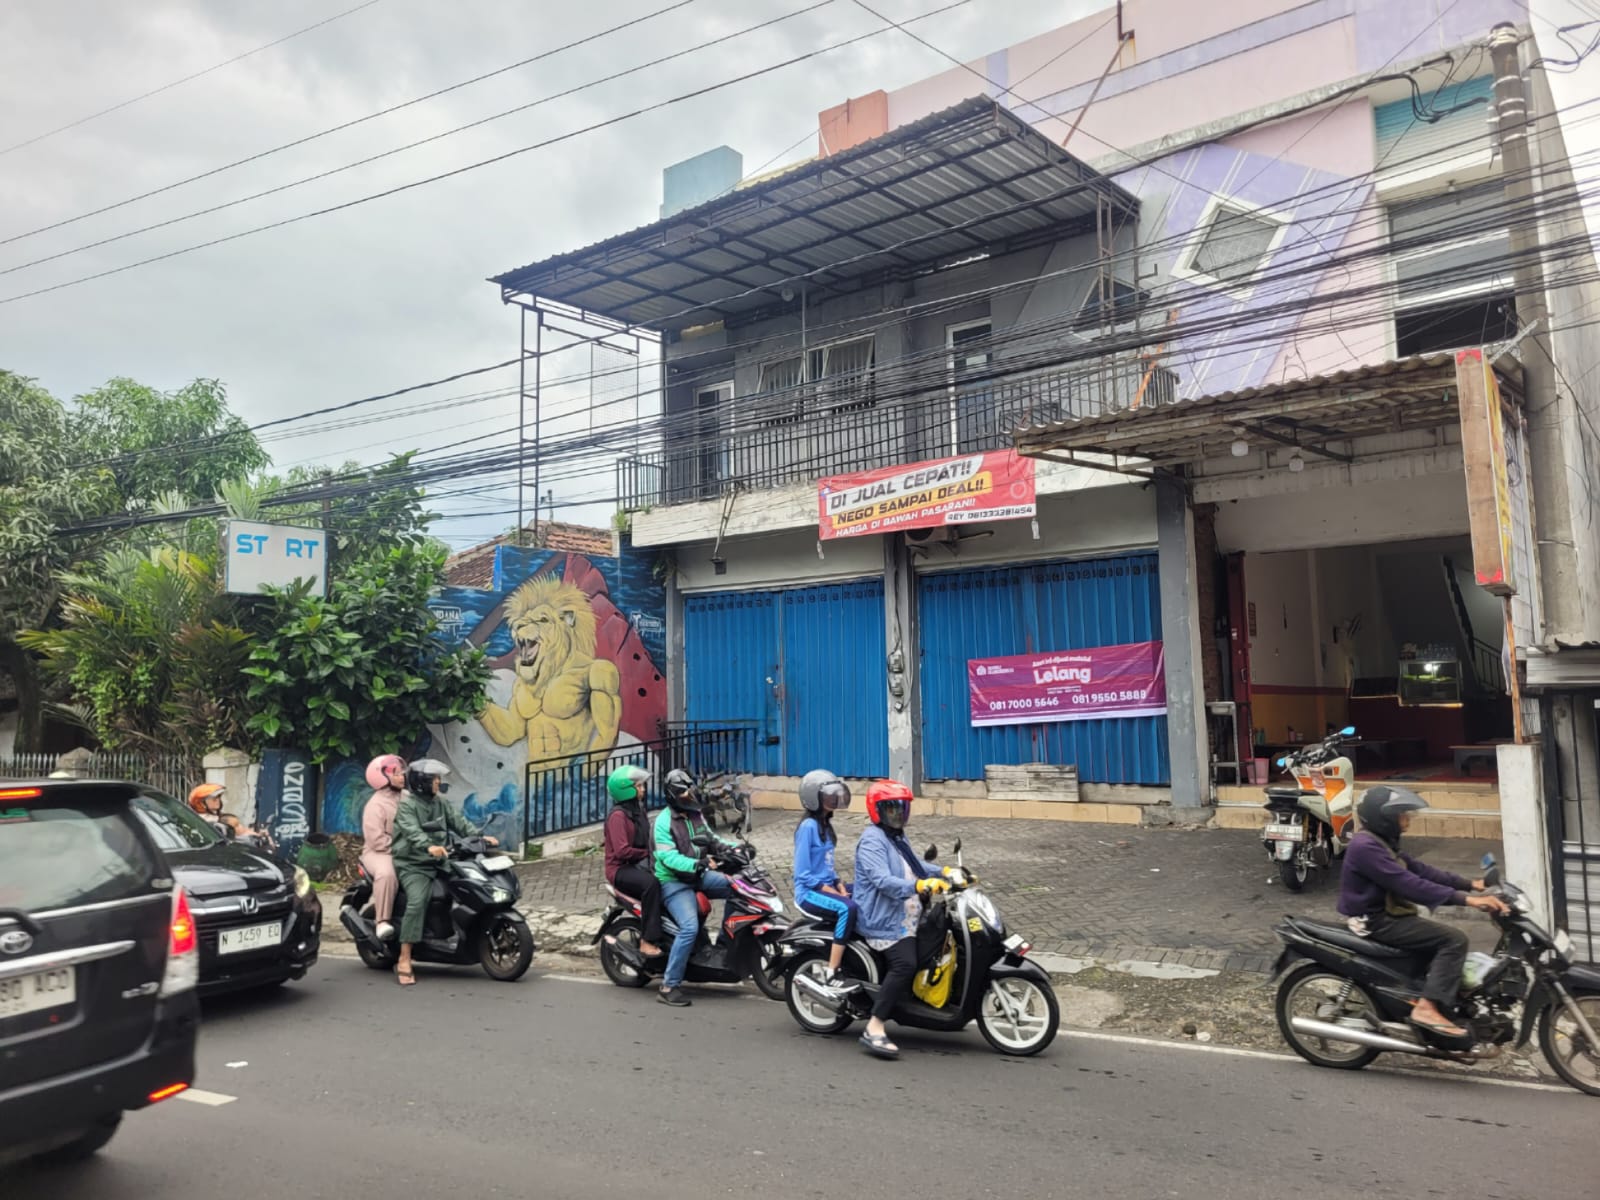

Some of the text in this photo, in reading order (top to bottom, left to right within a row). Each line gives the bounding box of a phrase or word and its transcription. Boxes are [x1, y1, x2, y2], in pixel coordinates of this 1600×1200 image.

[830, 459, 973, 511] DI JUAL CEPAT!!
[837, 479, 985, 525] NEGO SAMPAI DEAL!!
[836, 498, 977, 538] HARGA DI BAWAH PASARAN!!
[236, 533, 320, 559] ST RT
[1033, 666, 1092, 684] Lelang
[989, 697, 1059, 711] 081 7000 5646
[1072, 694, 1090, 704] 081
[1091, 692, 1117, 703] 9550
[222, 934, 229, 946] N
